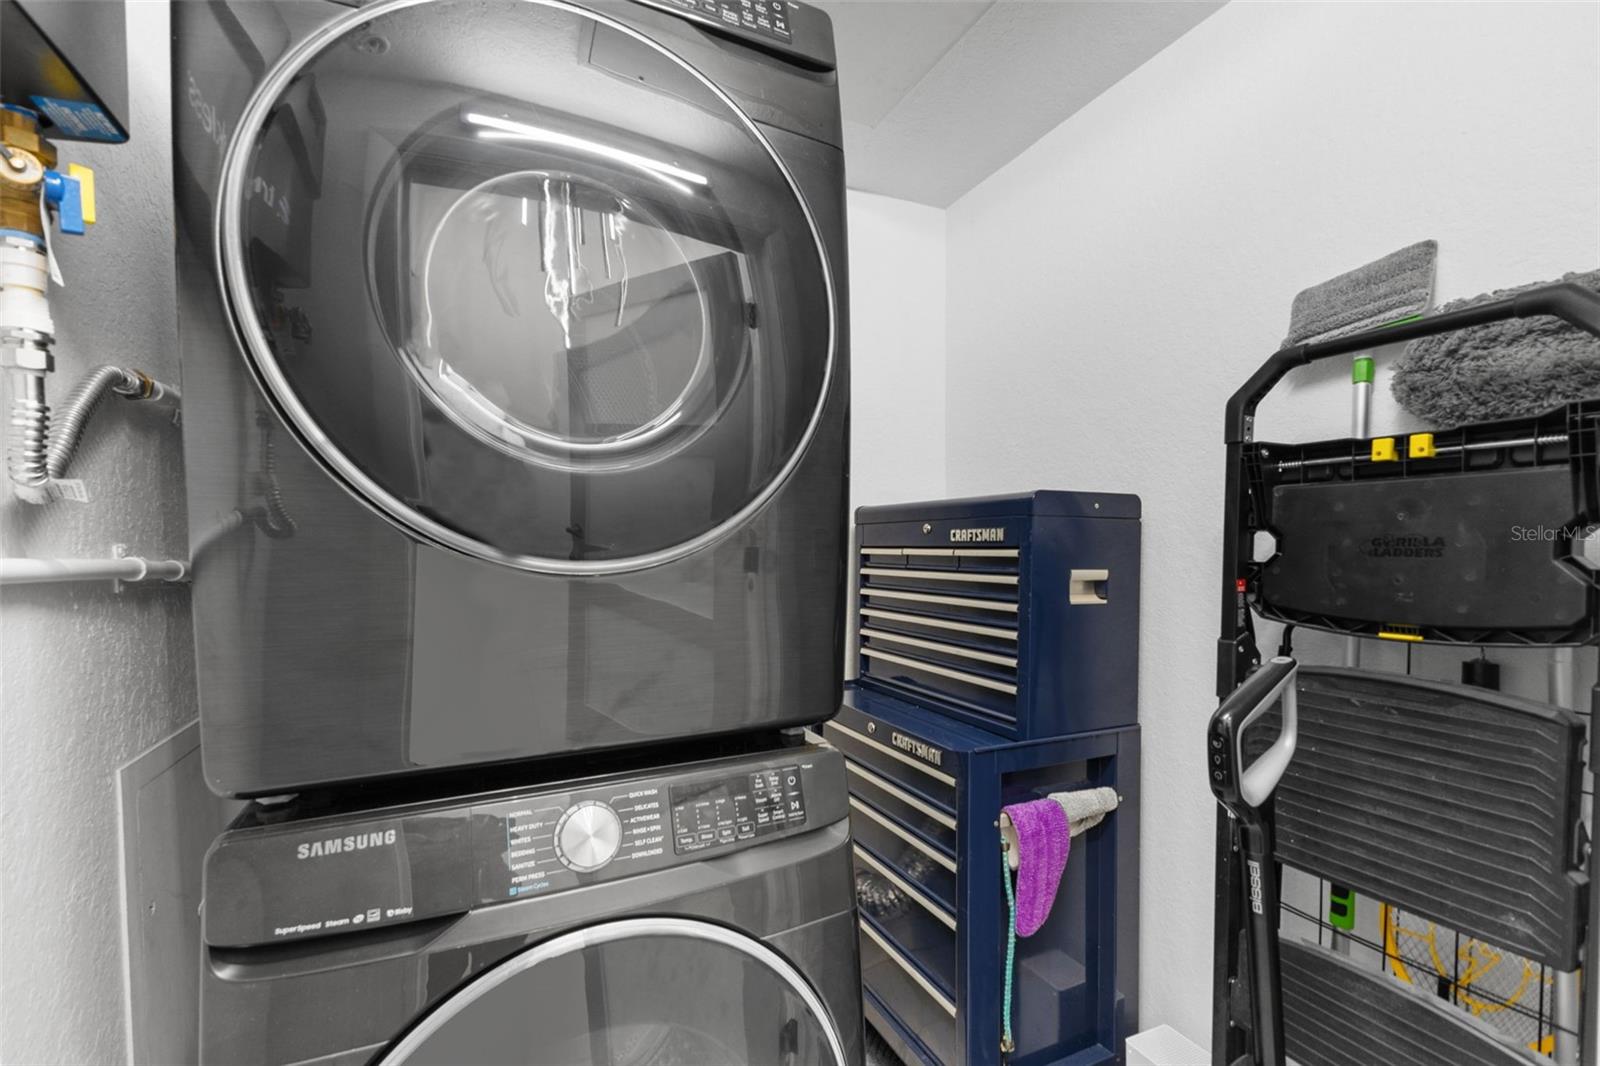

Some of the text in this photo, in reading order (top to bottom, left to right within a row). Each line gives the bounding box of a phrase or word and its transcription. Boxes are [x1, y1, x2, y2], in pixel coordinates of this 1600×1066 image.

[950, 527, 1004, 542] CRAFTSMAN
[892, 731, 943, 766] CRAFTSMAN
[296, 829, 396, 859] SAMSUNG
[325, 918, 350, 928] Steam
